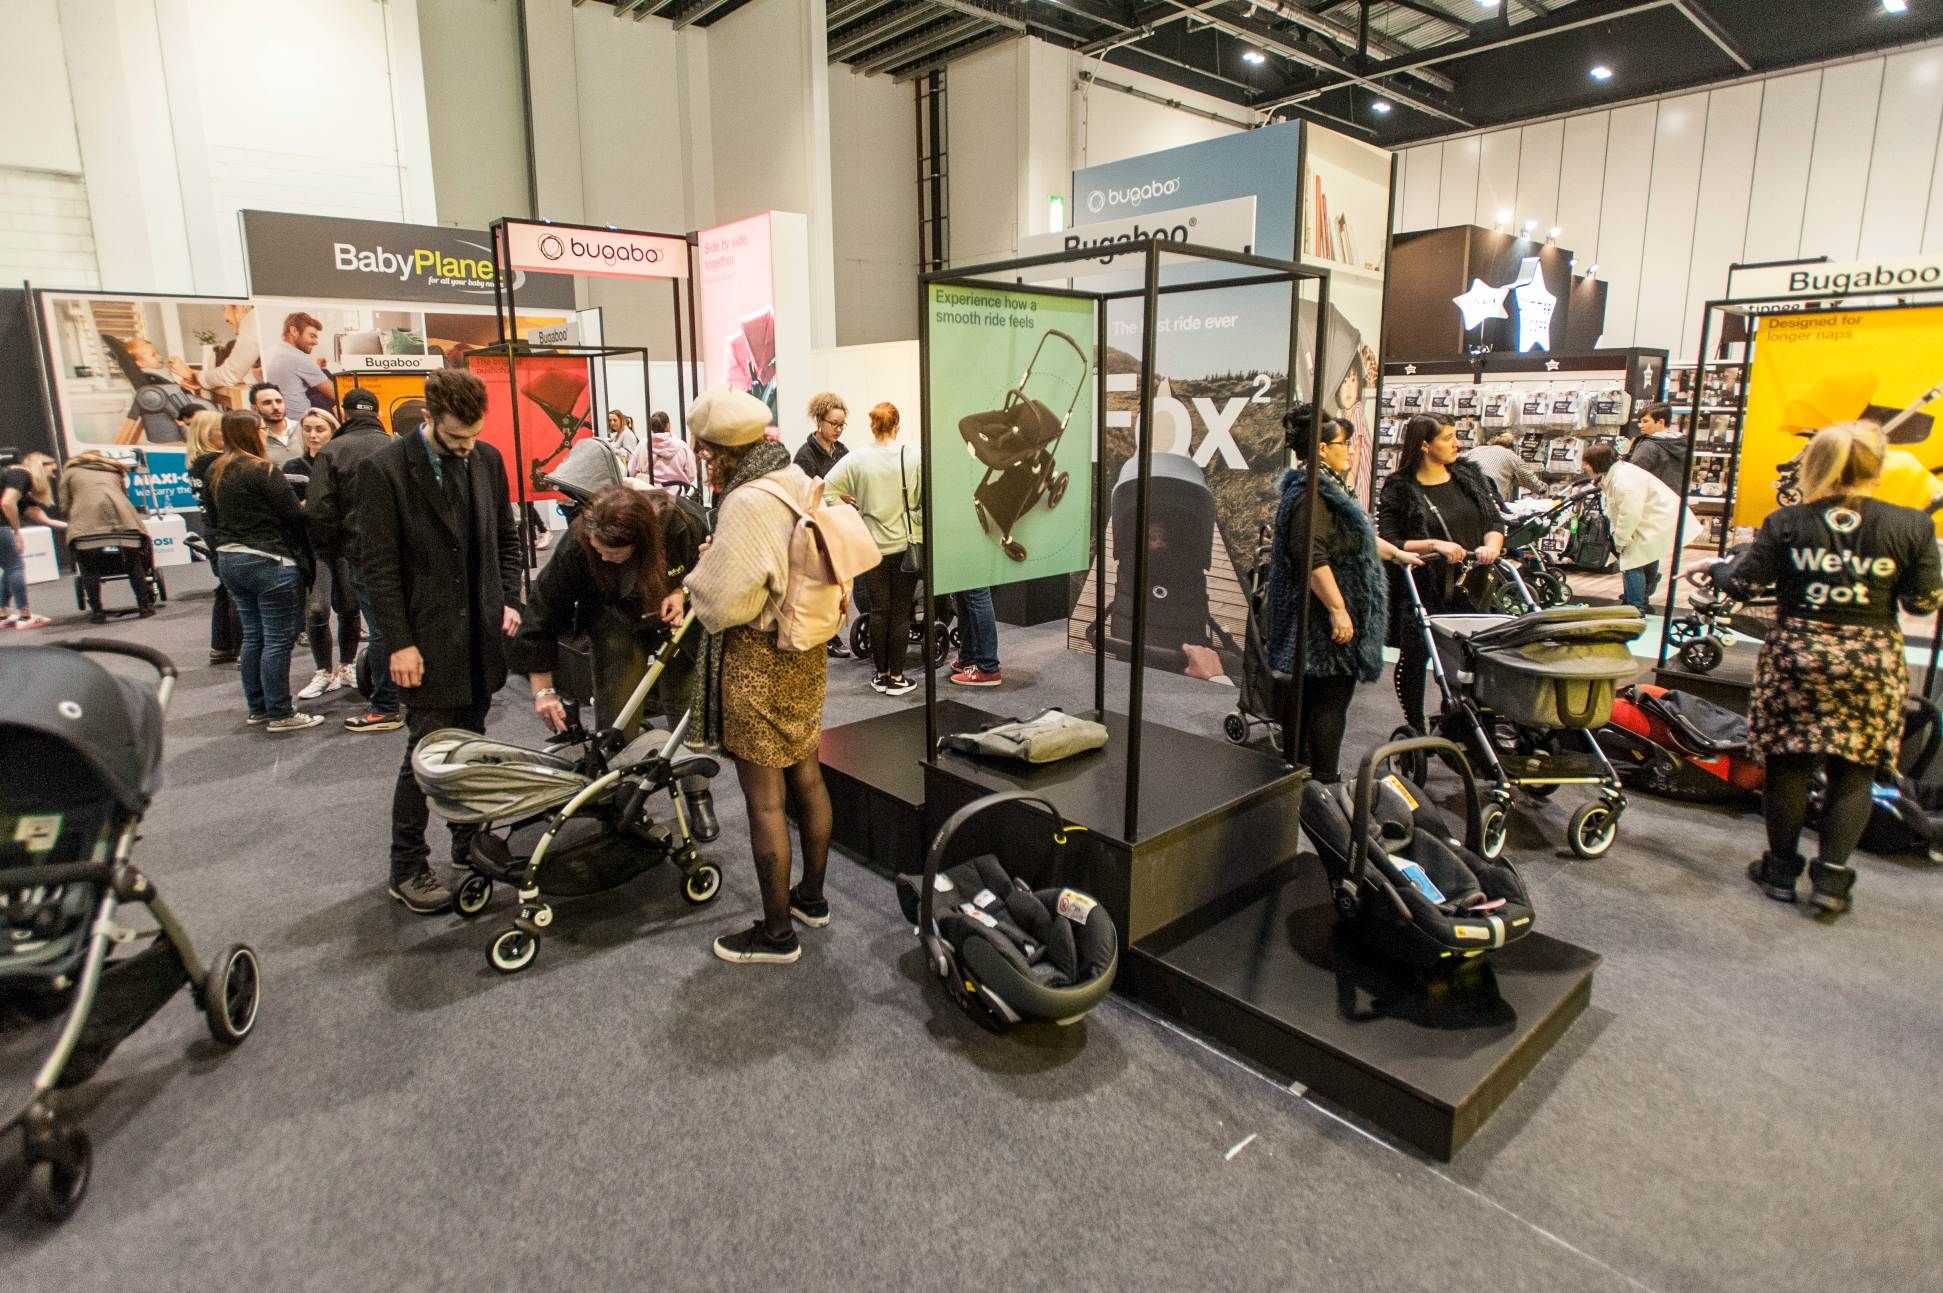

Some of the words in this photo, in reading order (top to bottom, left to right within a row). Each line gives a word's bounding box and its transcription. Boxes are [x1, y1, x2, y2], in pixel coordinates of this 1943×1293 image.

[334, 242, 503, 281] BabyPlane
[428, 276, 439, 286] for
[440, 277, 450, 285] all
[450, 278, 467, 288] your
[467, 279, 485, 289] baby
[936, 289, 1001, 308] Experience
[1004, 296, 1027, 311] how
[1030, 301, 1037, 311] a
[936, 311, 980, 325] smooth
[984, 313, 1006, 327] ride
[1009, 315, 1034, 329] feels
[1112, 320, 1137, 336] The
[1173, 315, 1201, 331] ride
[1205, 314, 1239, 329] ever
[1769, 316, 1837, 329] Designed
[1841, 315, 1863, 326] for
[1767, 332, 1811, 344] longer
[1816, 331, 1853, 343] naps
[1790, 547, 1897, 577] We've
[1805, 581, 1870, 605] got
